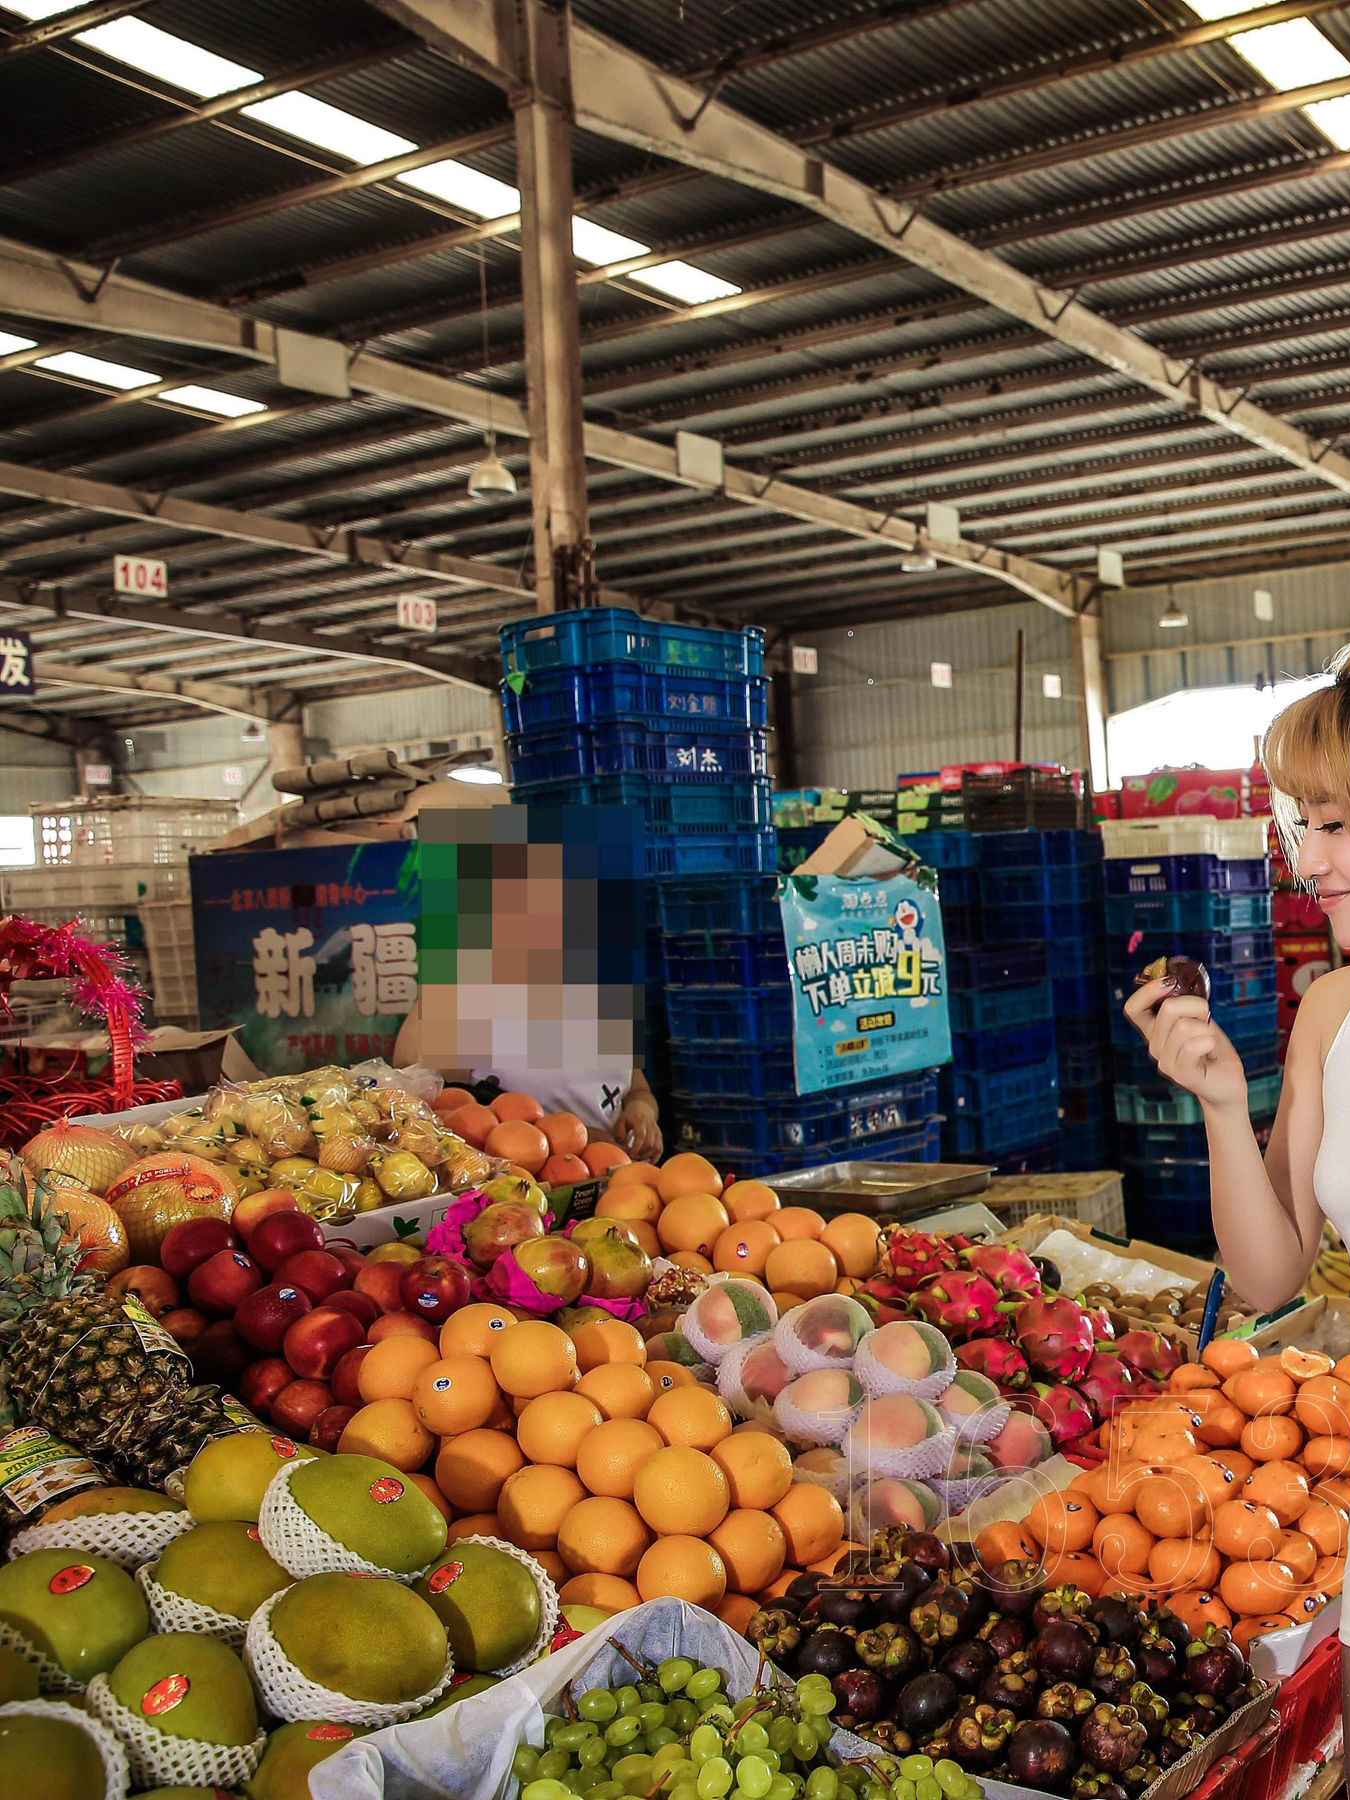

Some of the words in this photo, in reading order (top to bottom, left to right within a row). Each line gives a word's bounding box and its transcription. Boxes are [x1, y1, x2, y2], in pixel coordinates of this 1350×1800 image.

[119, 562, 165, 592] 104
[402, 600, 435, 626] 103
[675, 746, 723, 772] 刘杰
[252, 922, 419, 1019] 新疆
[802, 950, 941, 1015] 下单立减9元
[4, 1448, 71, 1476] PINEAPPLE
